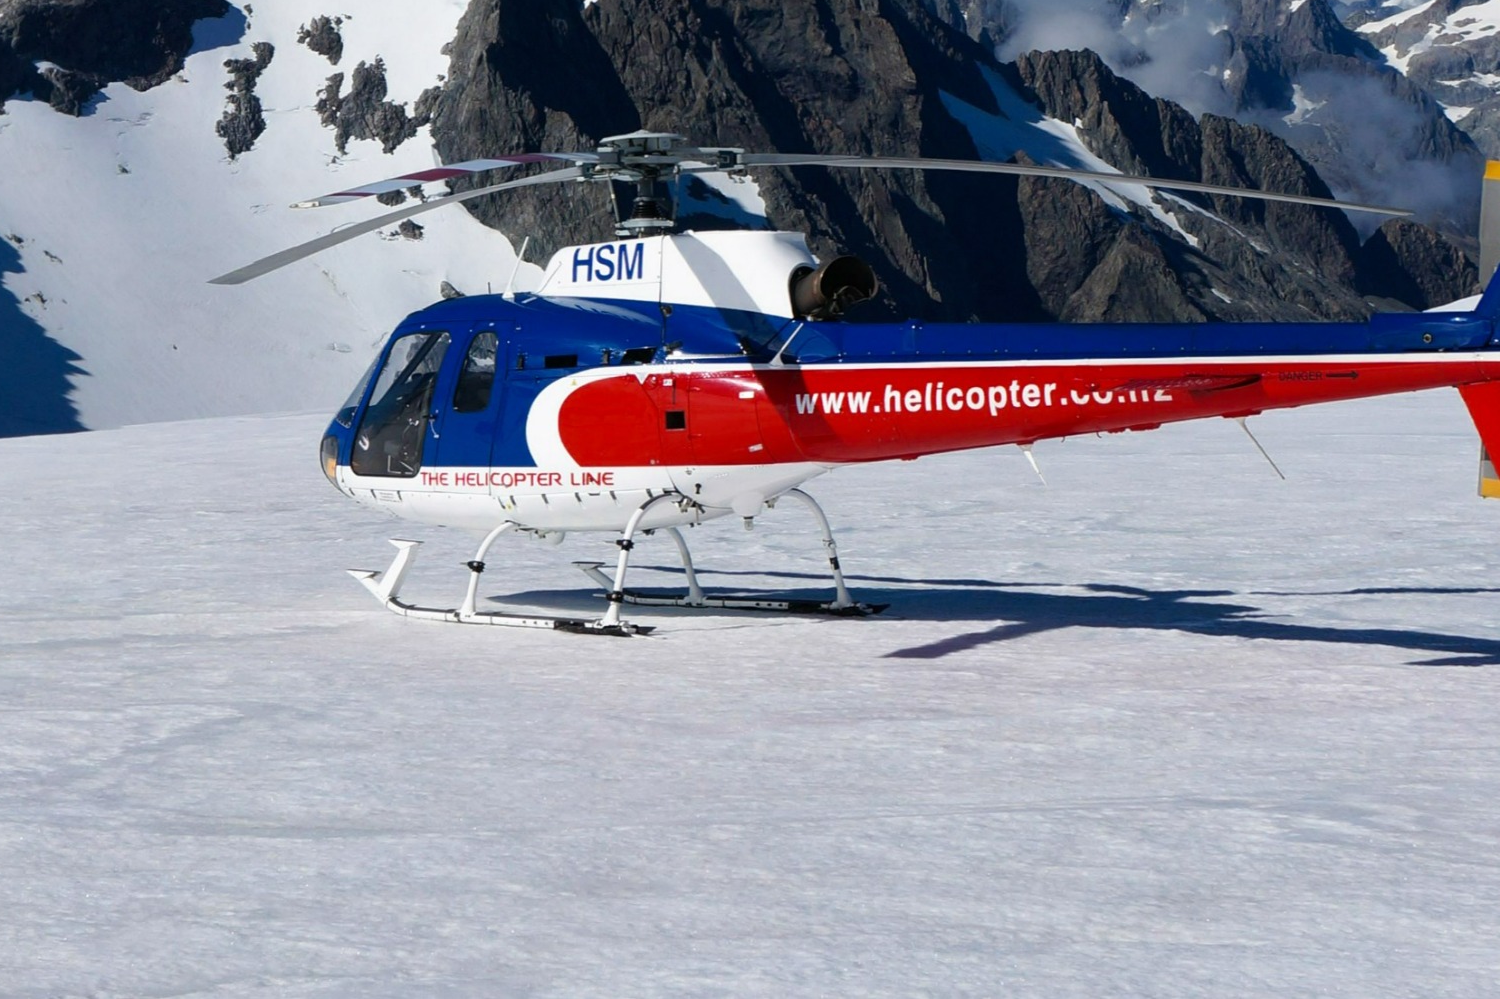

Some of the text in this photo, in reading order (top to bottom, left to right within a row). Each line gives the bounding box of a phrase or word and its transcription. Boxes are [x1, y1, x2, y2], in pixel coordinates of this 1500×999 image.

[572, 242, 644, 282] HSM
[1278, 371, 1323, 381] DANGER
[420, 472, 614, 487] THE HELICOPTER LINE
